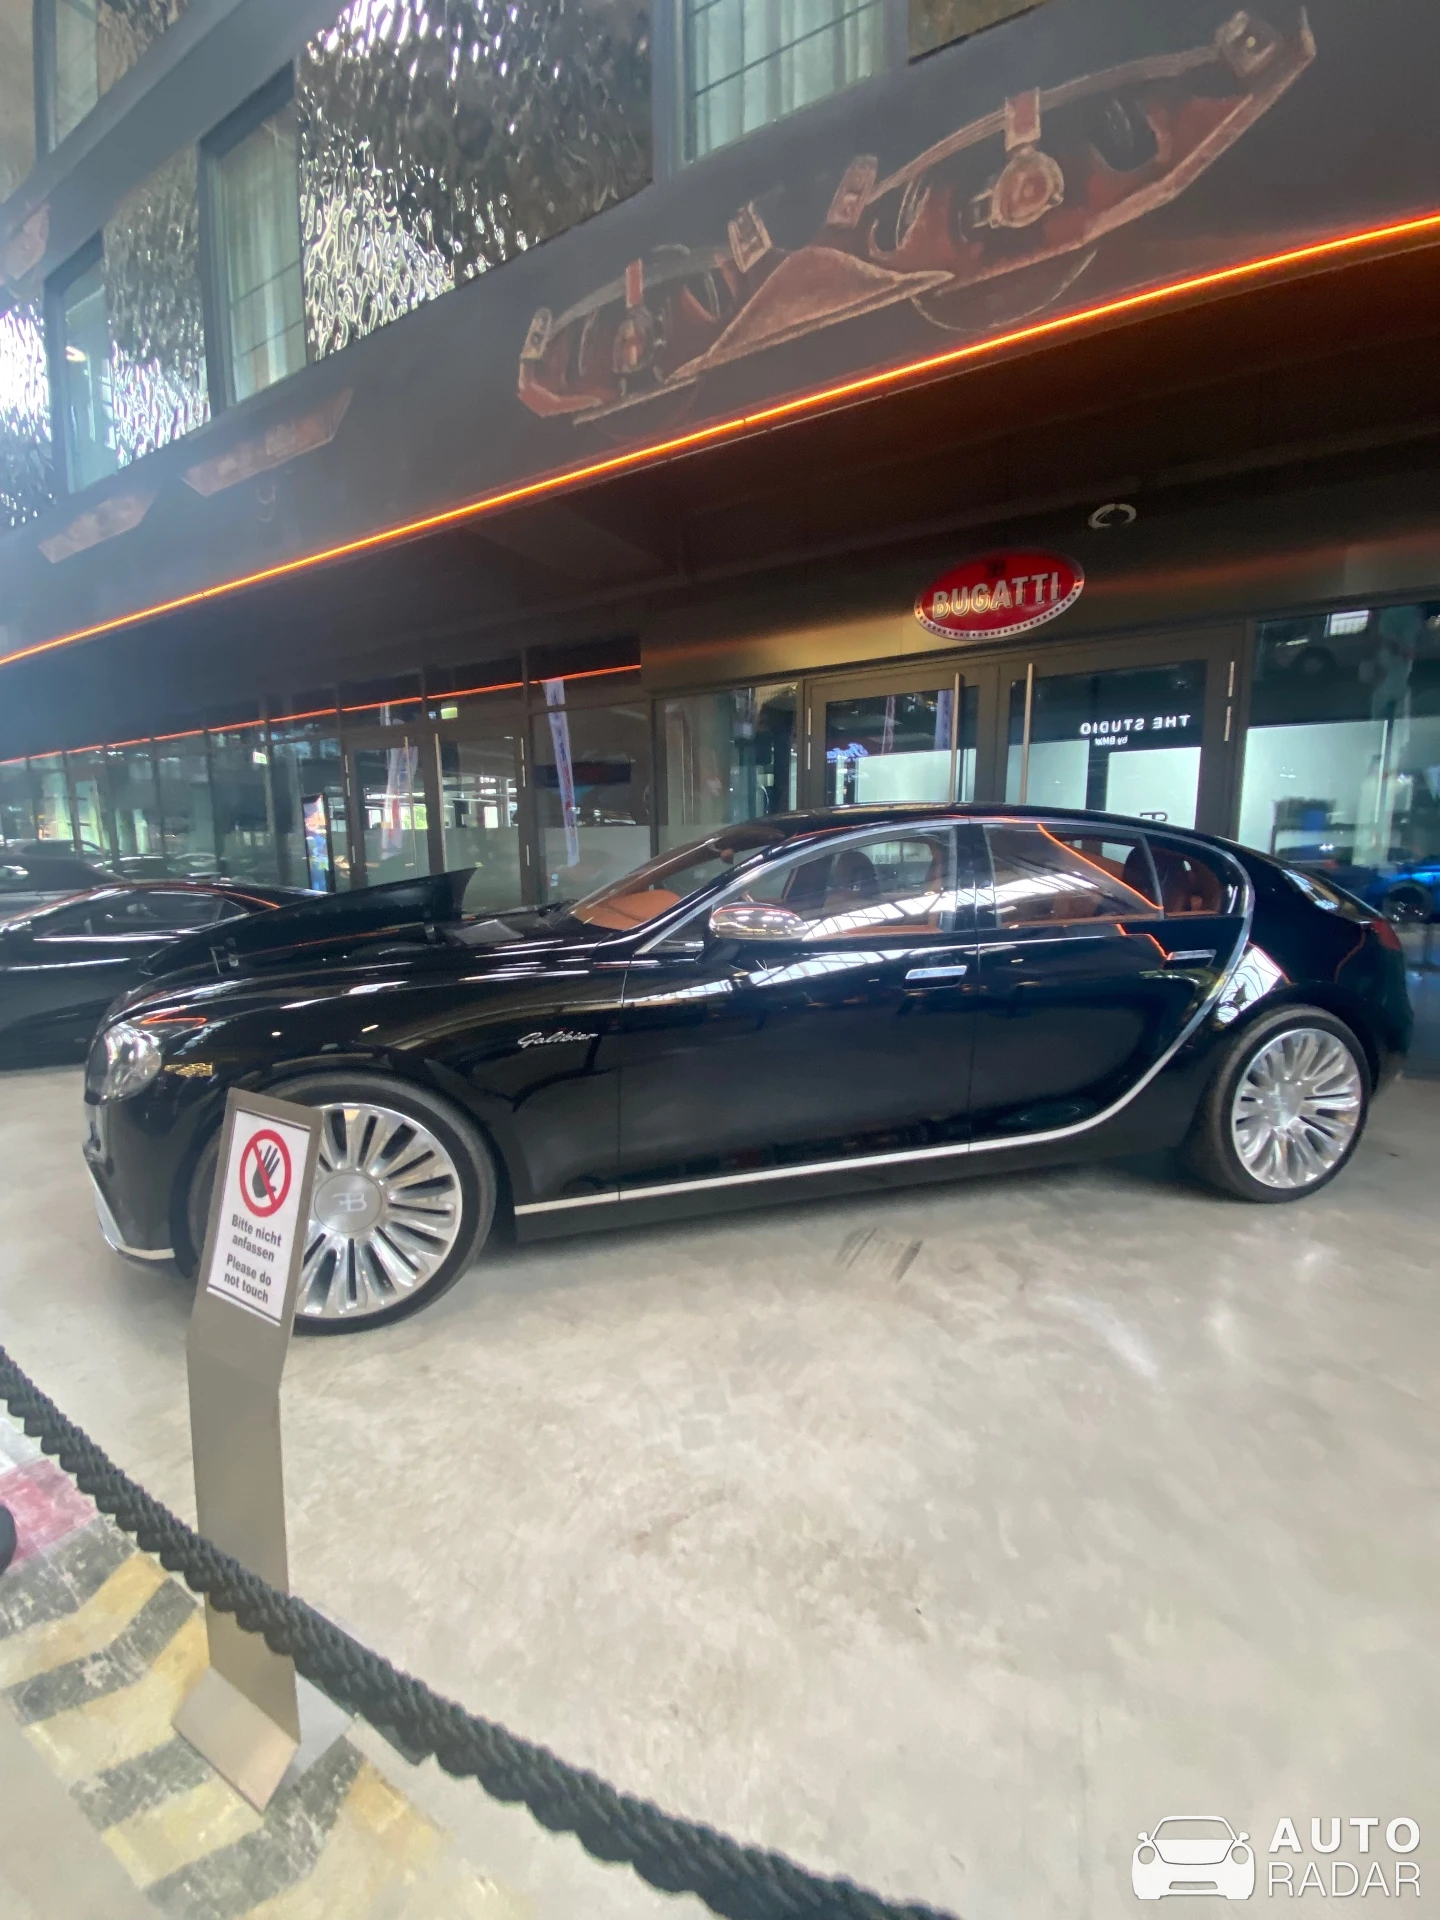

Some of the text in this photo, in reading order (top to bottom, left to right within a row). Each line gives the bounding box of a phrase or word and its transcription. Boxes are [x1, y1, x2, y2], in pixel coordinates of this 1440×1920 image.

[932, 572, 1060, 619] BUGATTI
[231, 1213, 282, 1247] Bitte nicht
[232, 1234, 275, 1262] anfassen
[226, 1252, 272, 1287] Please do
[223, 1272, 269, 1304] not touch
